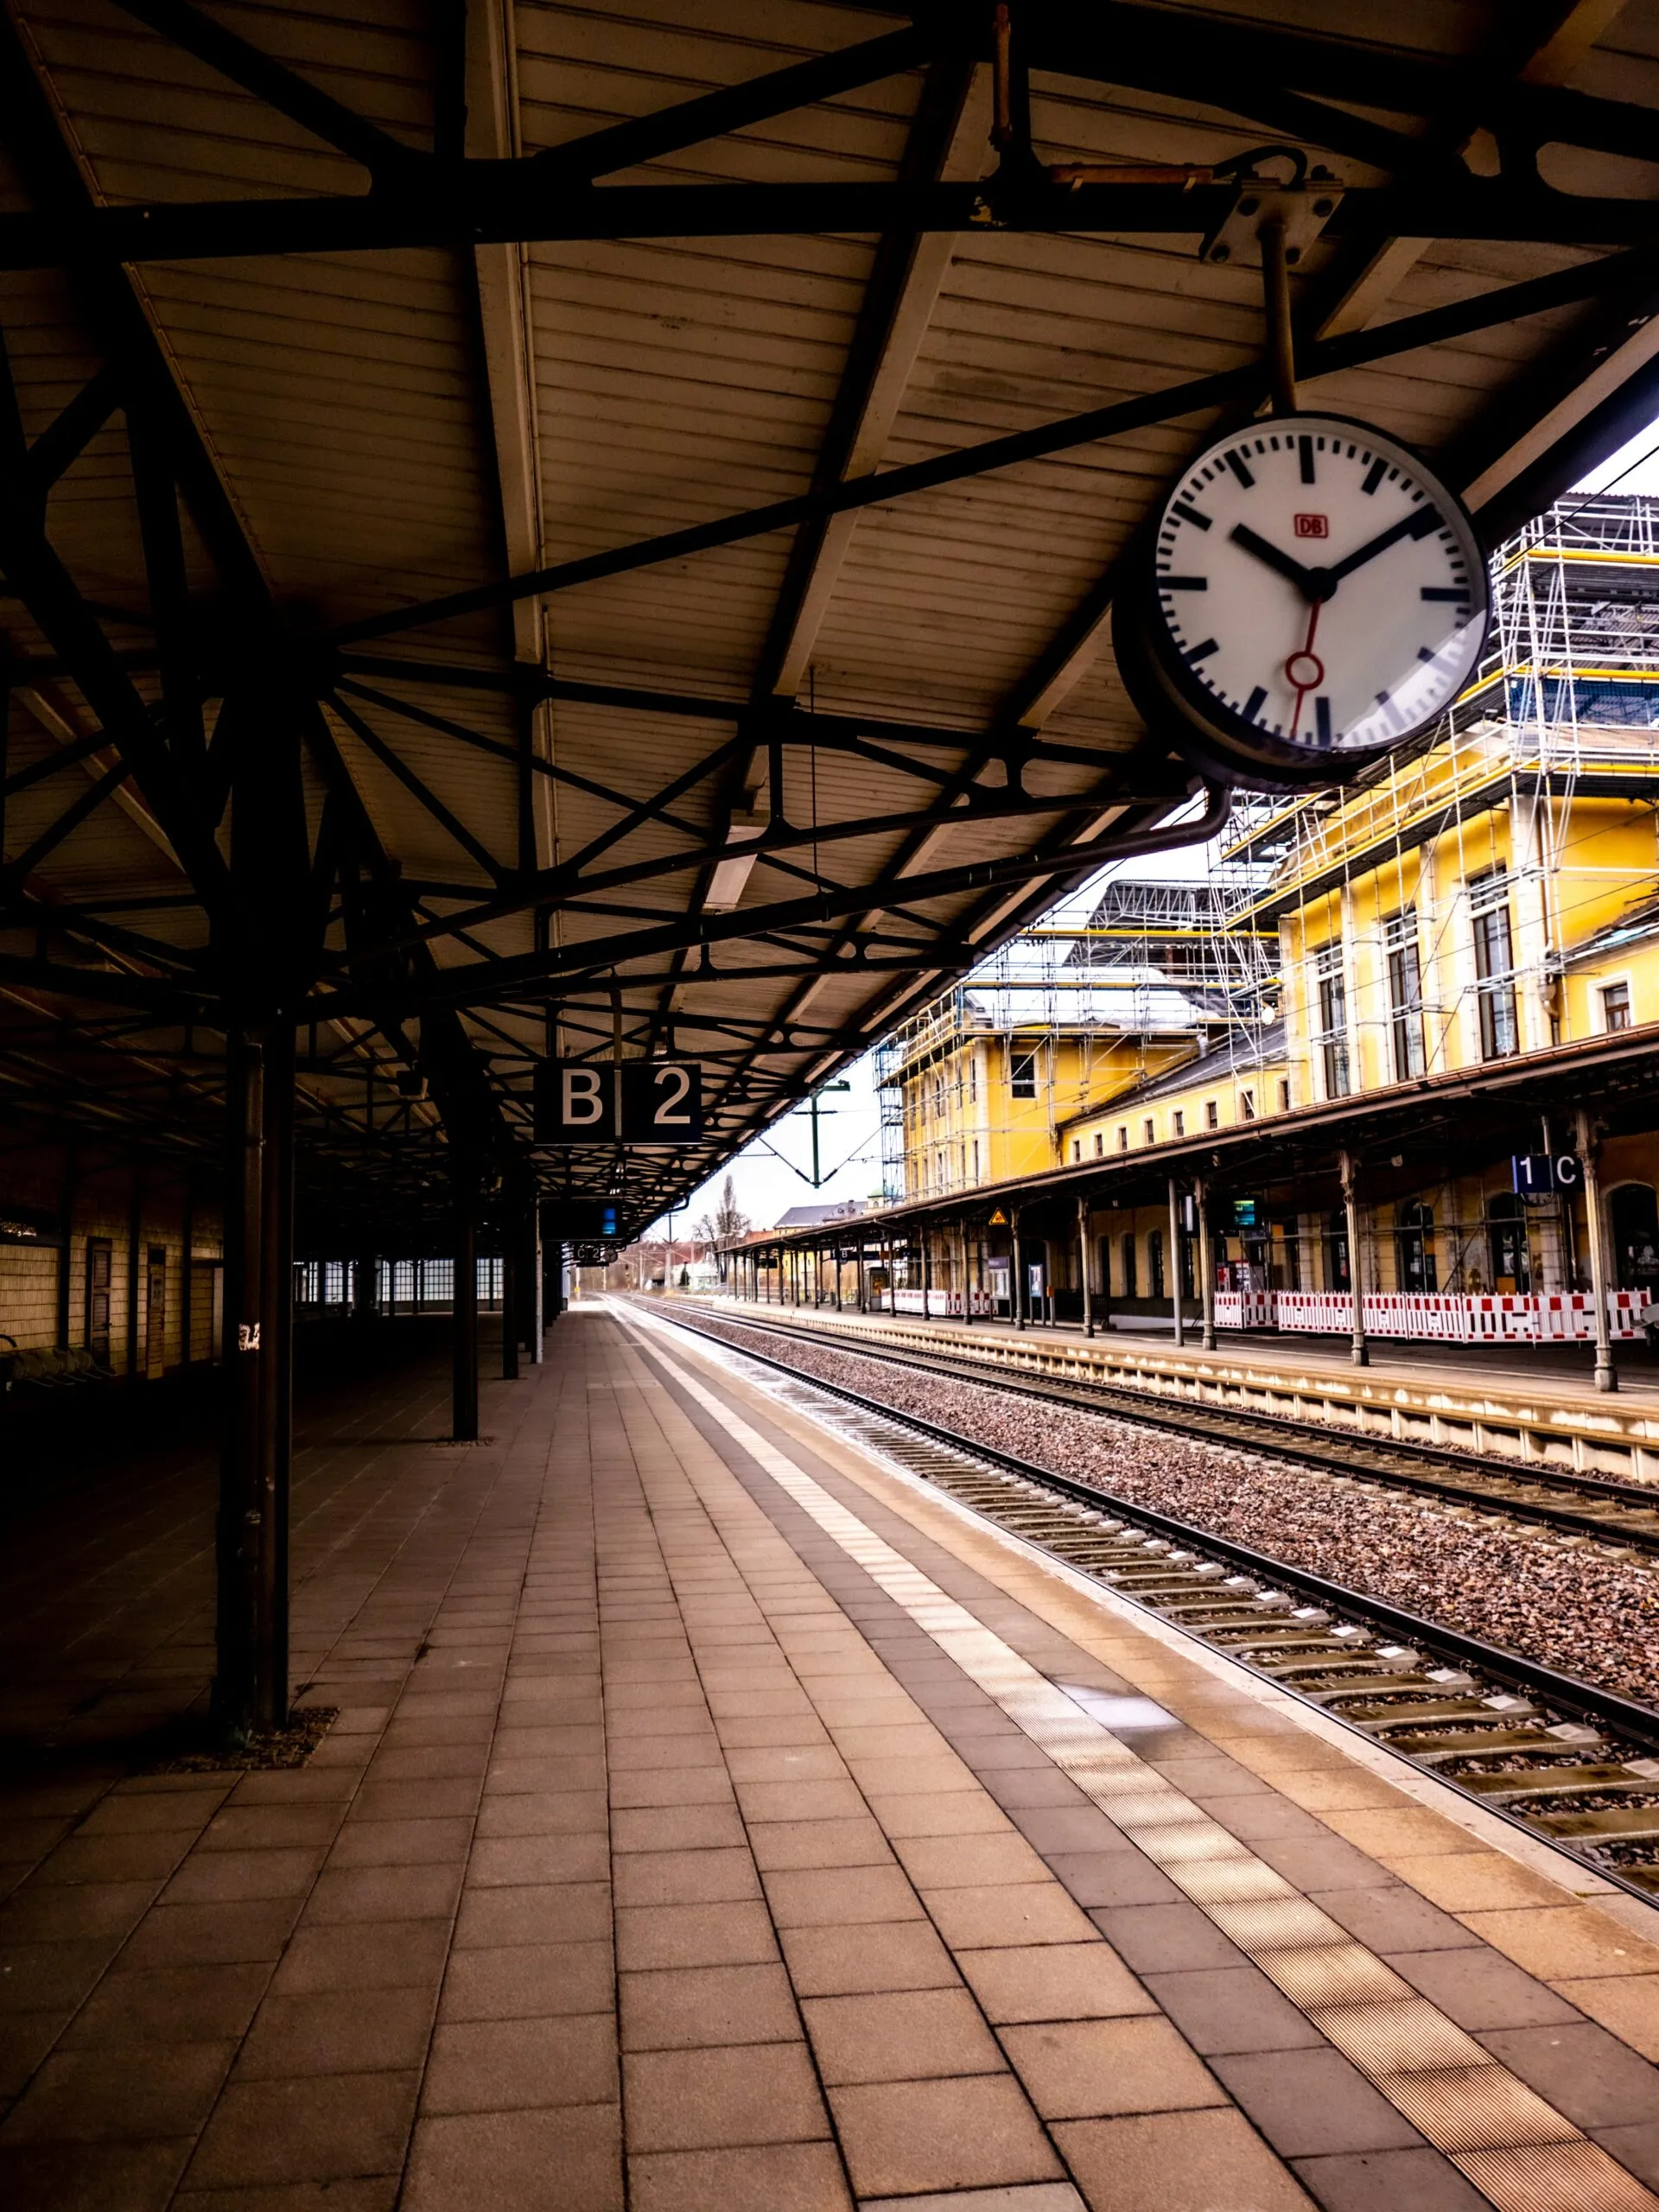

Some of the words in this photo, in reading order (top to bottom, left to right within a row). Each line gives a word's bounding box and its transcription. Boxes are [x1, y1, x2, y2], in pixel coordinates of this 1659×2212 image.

[1300, 518, 1323, 534] DB
[562, 1068, 603, 1125] B
[653, 1066, 691, 1125] 2
[1519, 1156, 1533, 1185] 1
[1556, 1155, 1577, 1185] C
[577, 1248, 586, 1259] C
[592, 1248, 600, 1259] 2
[841, 1249, 849, 1259] B
